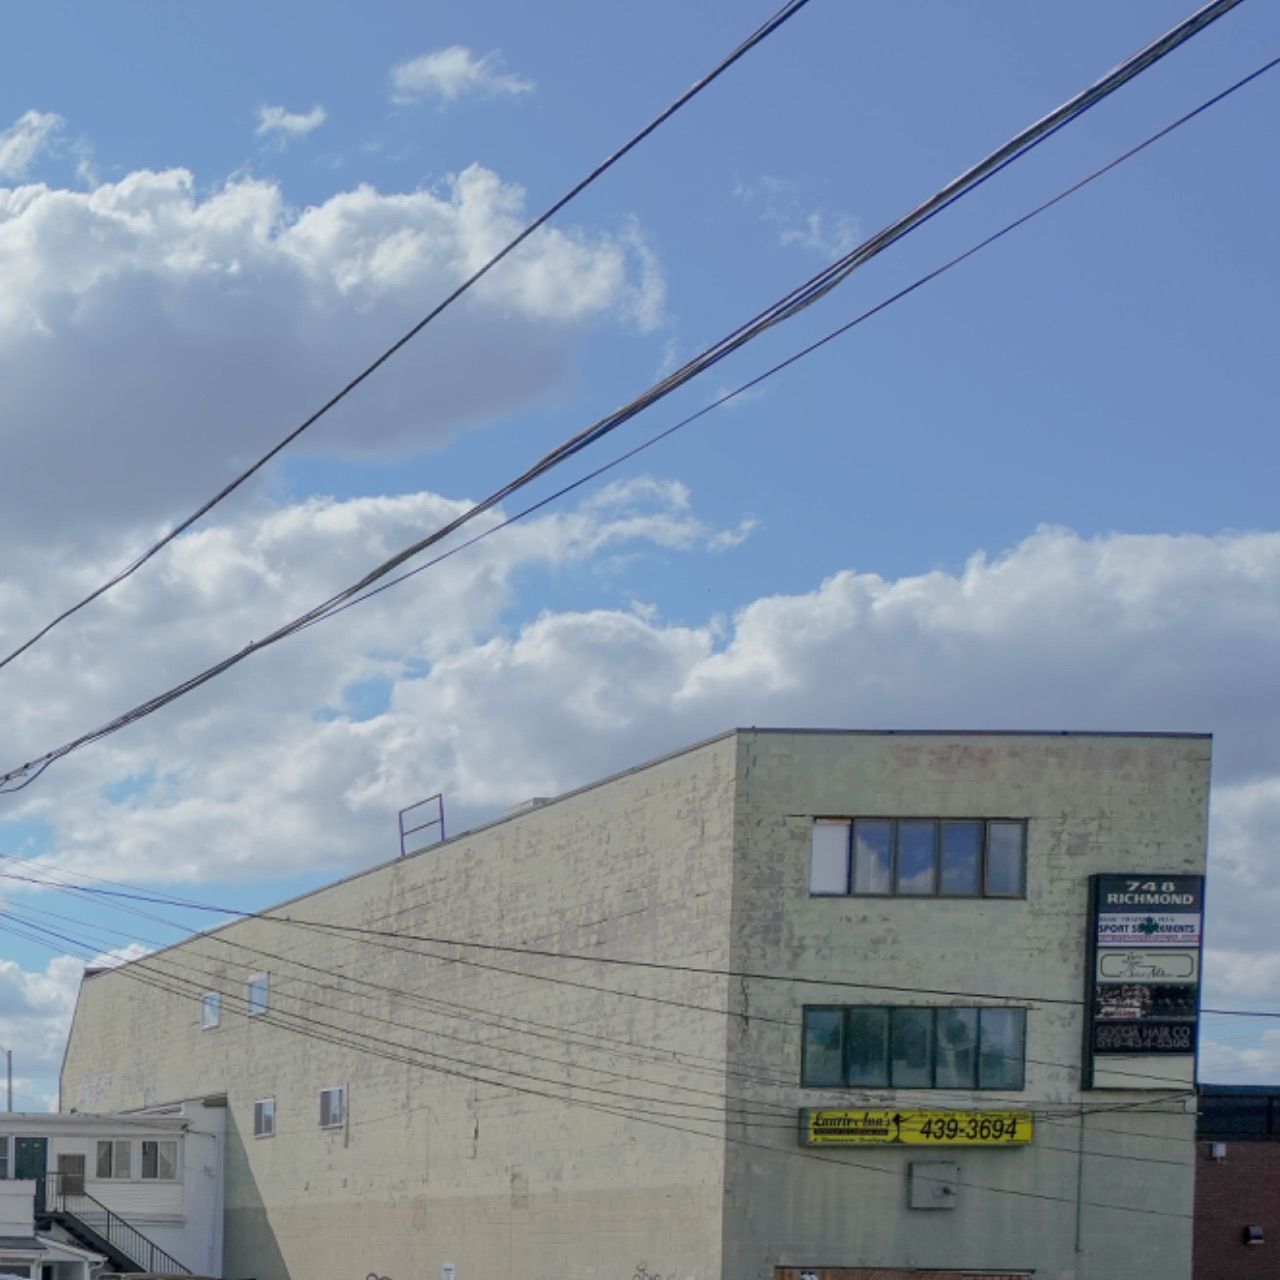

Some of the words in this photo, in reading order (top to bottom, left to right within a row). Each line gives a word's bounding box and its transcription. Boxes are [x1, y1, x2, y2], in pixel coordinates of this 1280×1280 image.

[1125, 881, 1176, 893] 748
[1107, 893, 1194, 905] RICHMOND
[1099, 924, 1129, 934] SPORT
[920, 1117, 1017, 1140] 439-3694
